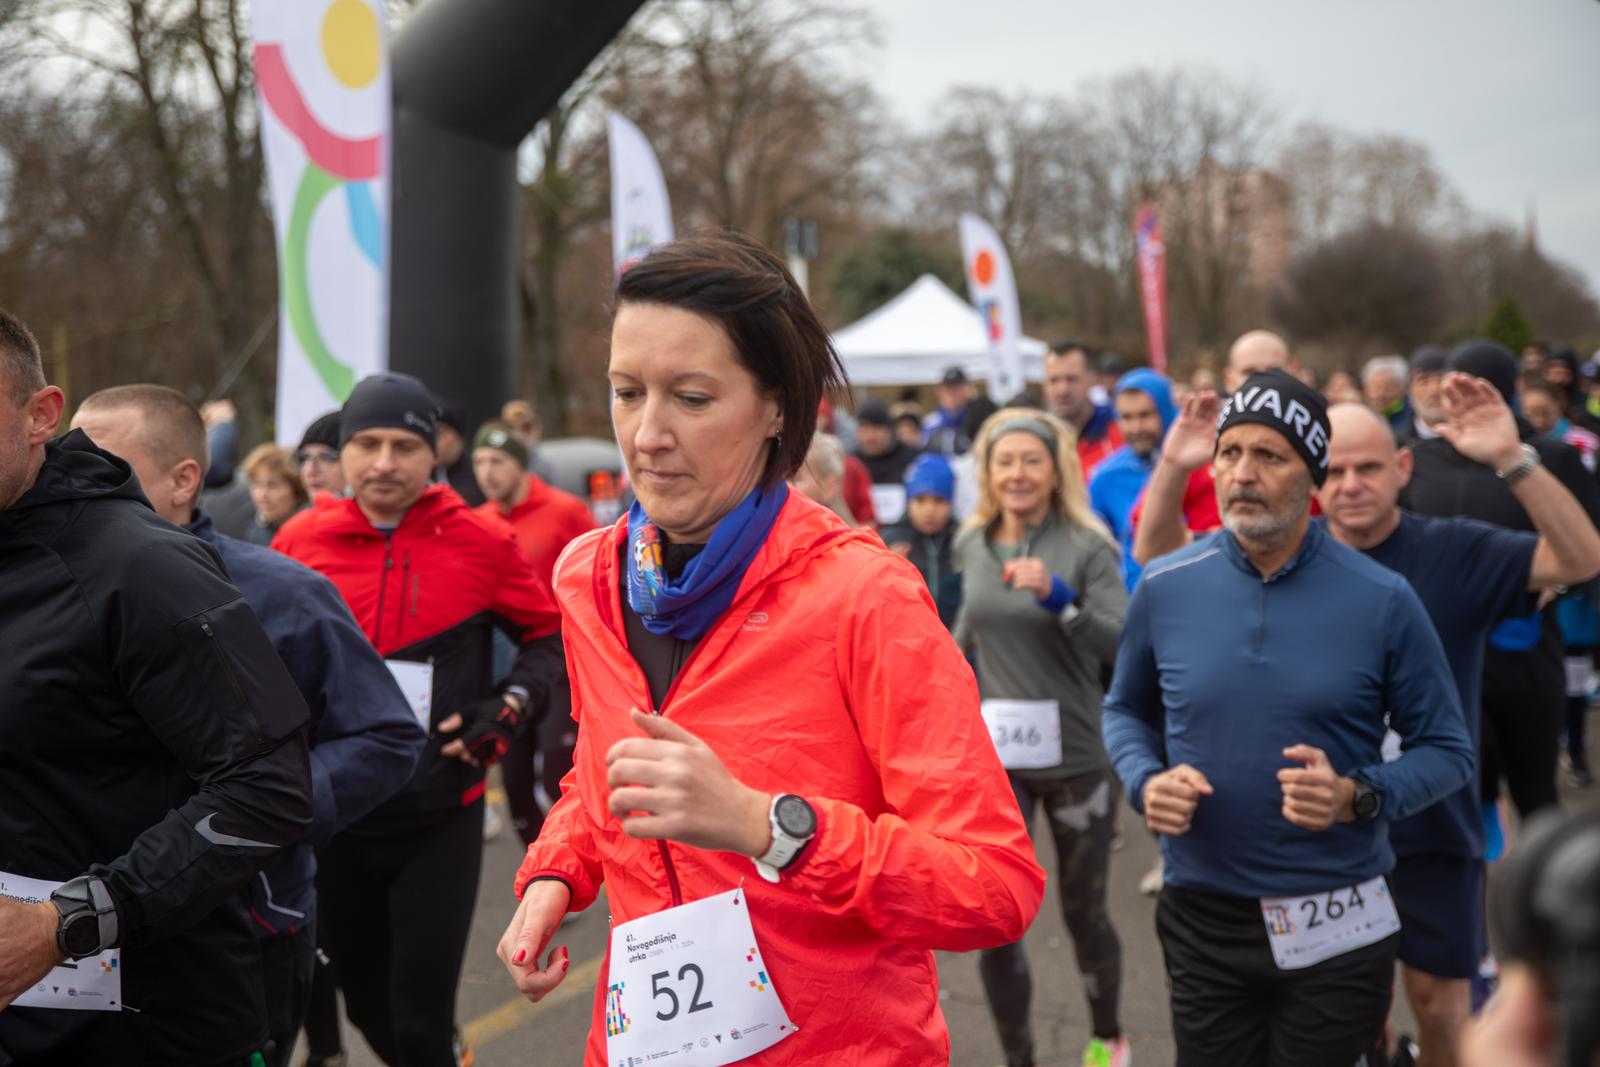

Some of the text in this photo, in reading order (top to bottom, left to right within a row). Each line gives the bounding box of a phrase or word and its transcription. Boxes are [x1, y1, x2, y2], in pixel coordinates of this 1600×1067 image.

[1301, 886, 1364, 929] 264
[626, 934, 637, 943] 41.
[627, 932, 677, 952] Novogodišnja
[651, 963, 713, 1021] 52
